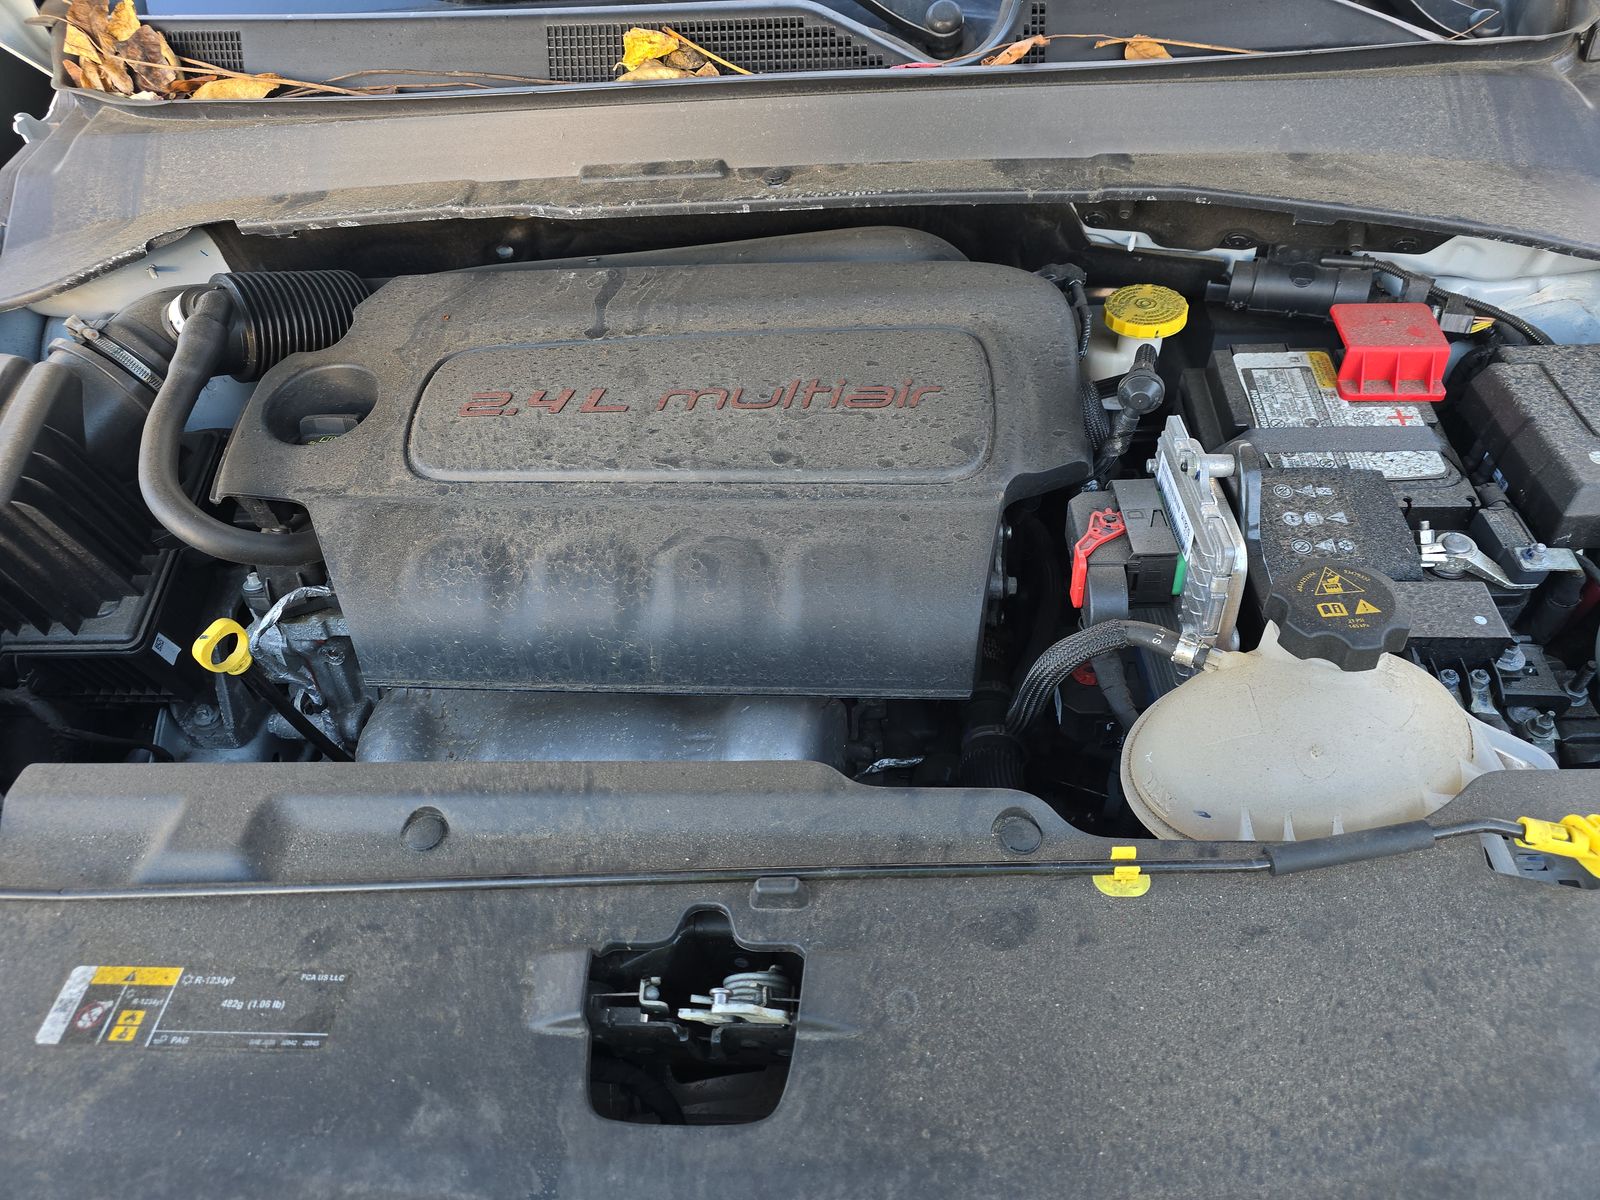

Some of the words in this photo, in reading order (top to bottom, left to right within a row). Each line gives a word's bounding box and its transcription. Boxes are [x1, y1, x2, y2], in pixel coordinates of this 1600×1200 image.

[459, 388, 629, 417] 2.4L
[656, 378, 943, 411] multiair
[194, 976, 236, 987] R-1234yf
[300, 973, 316, 981] FCA
[317, 974, 328, 982] US
[329, 974, 345, 982] LLC
[271, 999, 286, 1010] lb)
[170, 1036, 190, 1045] PAG
